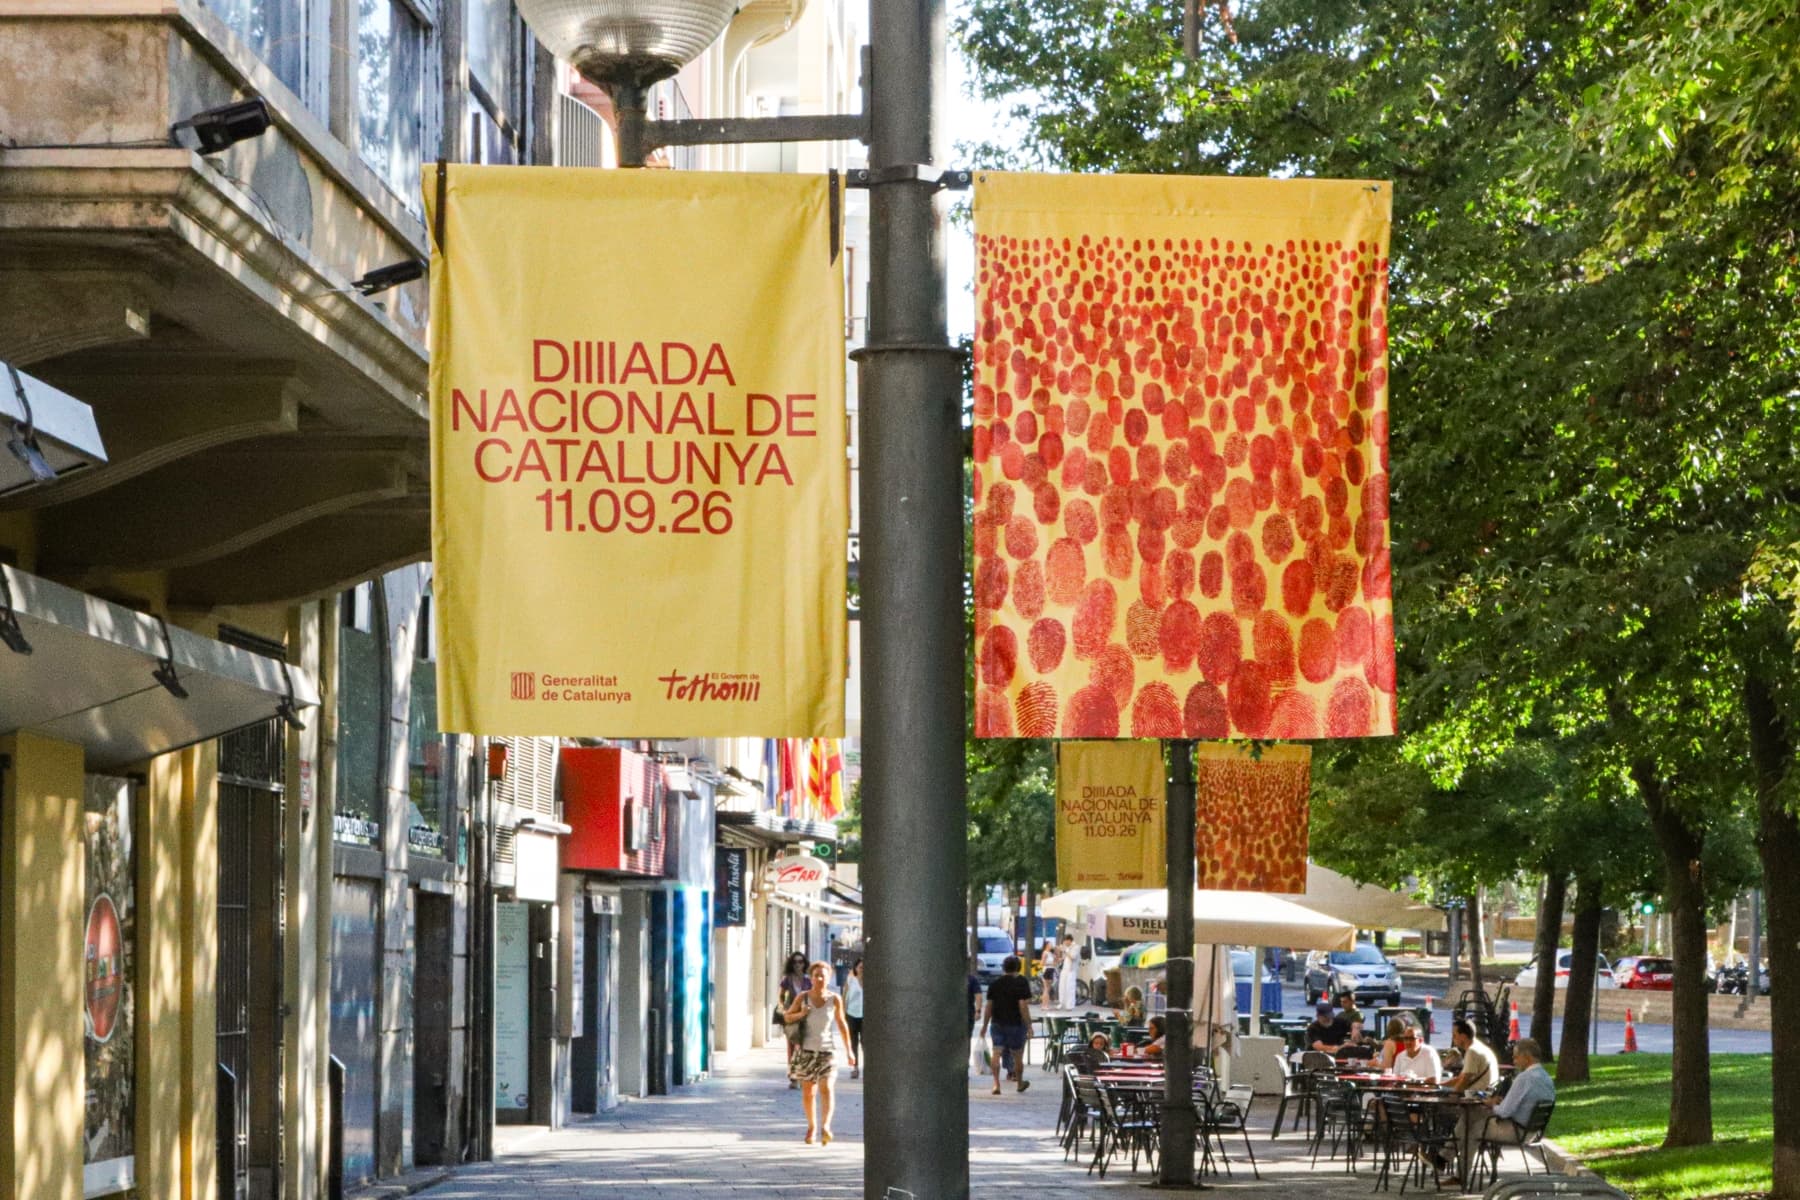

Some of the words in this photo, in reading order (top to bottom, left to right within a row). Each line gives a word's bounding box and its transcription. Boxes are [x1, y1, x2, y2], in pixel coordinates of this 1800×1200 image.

[452, 388, 735, 437] NACIONAL
[746, 393, 817, 438] DE
[474, 438, 794, 487] CATALUNYA
[536, 488, 734, 535] 11.09.26
[541, 674, 618, 687] Generalitat
[541, 690, 559, 701] de
[562, 689, 632, 704] Catalunya
[1061, 799, 1137, 811] NACIONAL
[1139, 798, 1158, 810] DE
[1067, 811, 1152, 824] CATALUNYA
[1085, 824, 1137, 837] 11.09.26
